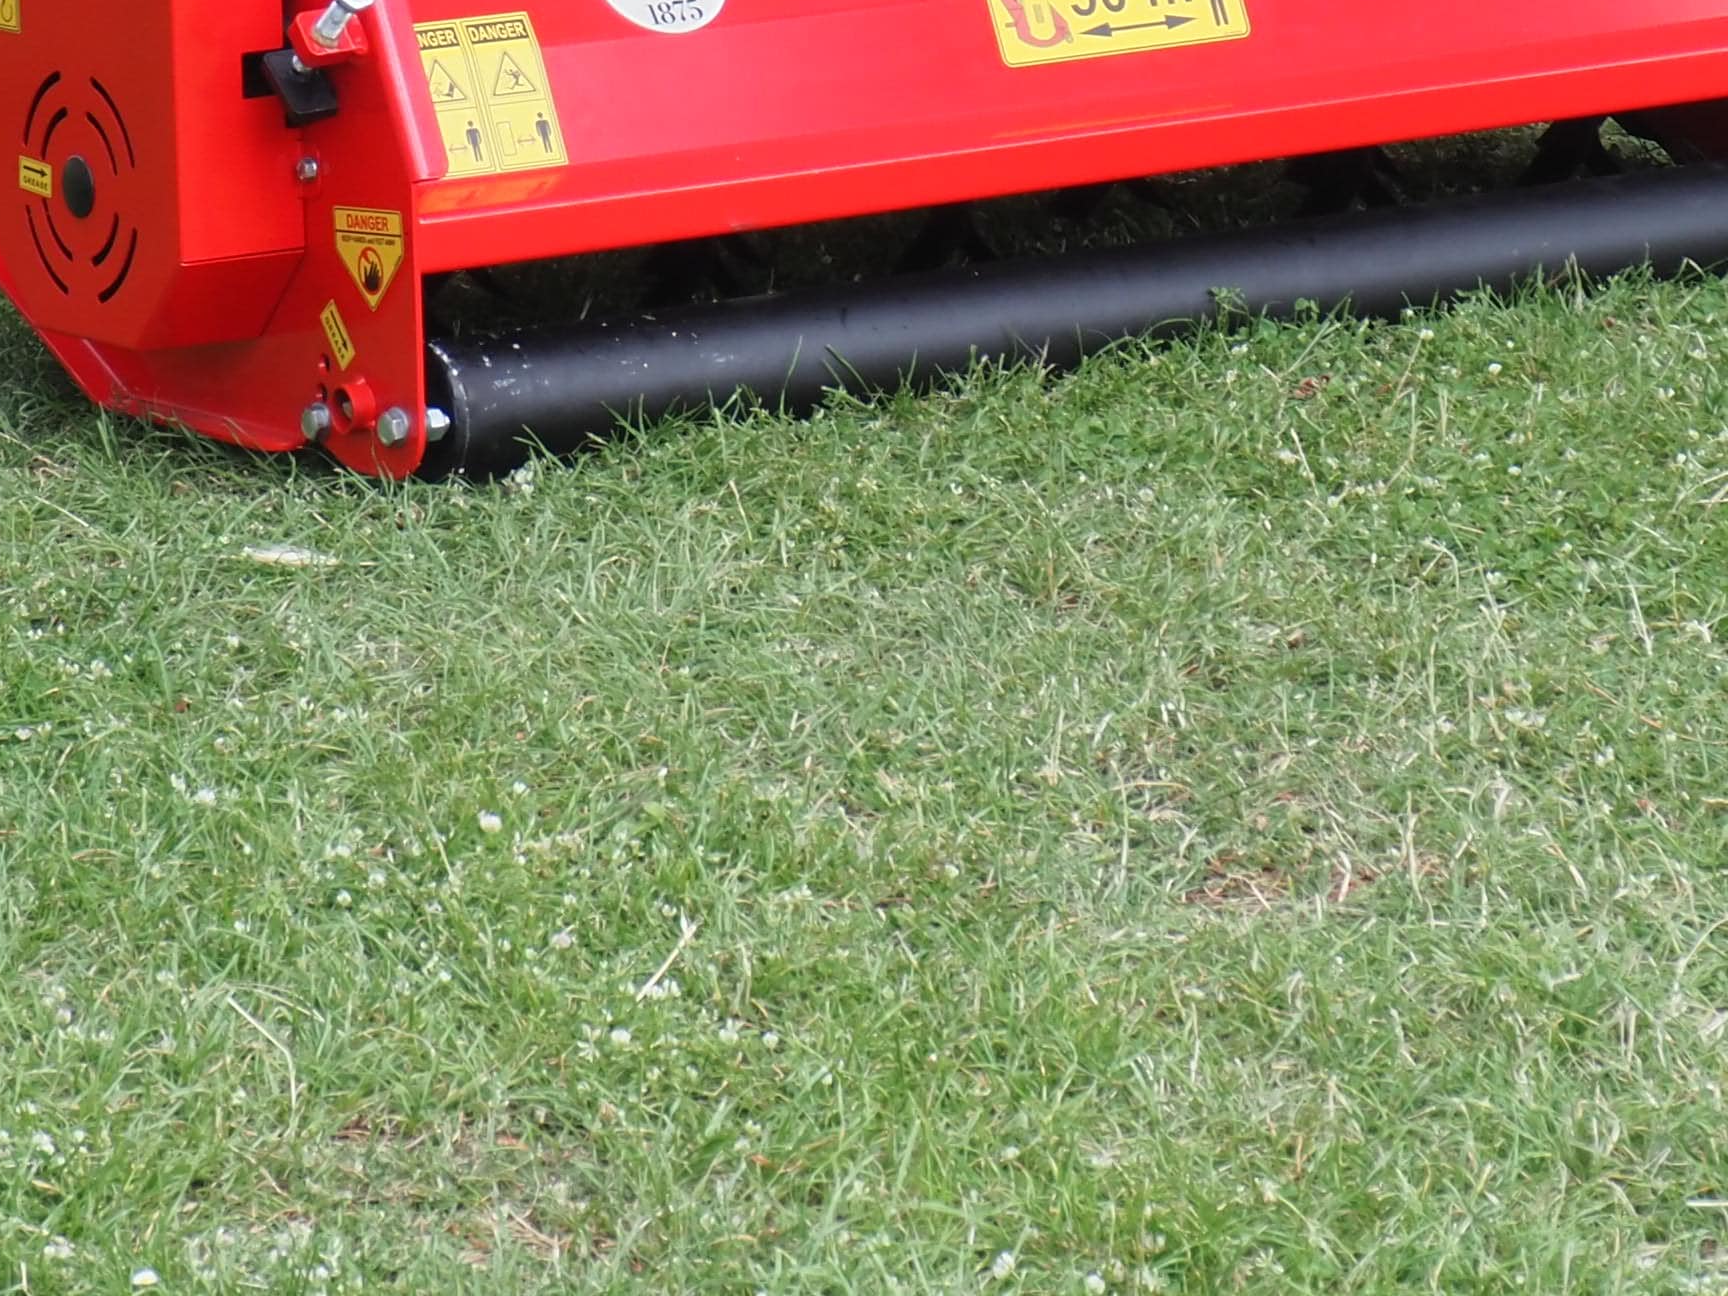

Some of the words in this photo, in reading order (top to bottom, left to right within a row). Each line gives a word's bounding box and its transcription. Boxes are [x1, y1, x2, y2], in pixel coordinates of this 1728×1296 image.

[416, 29, 458, 48] NGER
[467, 21, 528, 42] DANGER
[346, 213, 390, 232] DANGER
